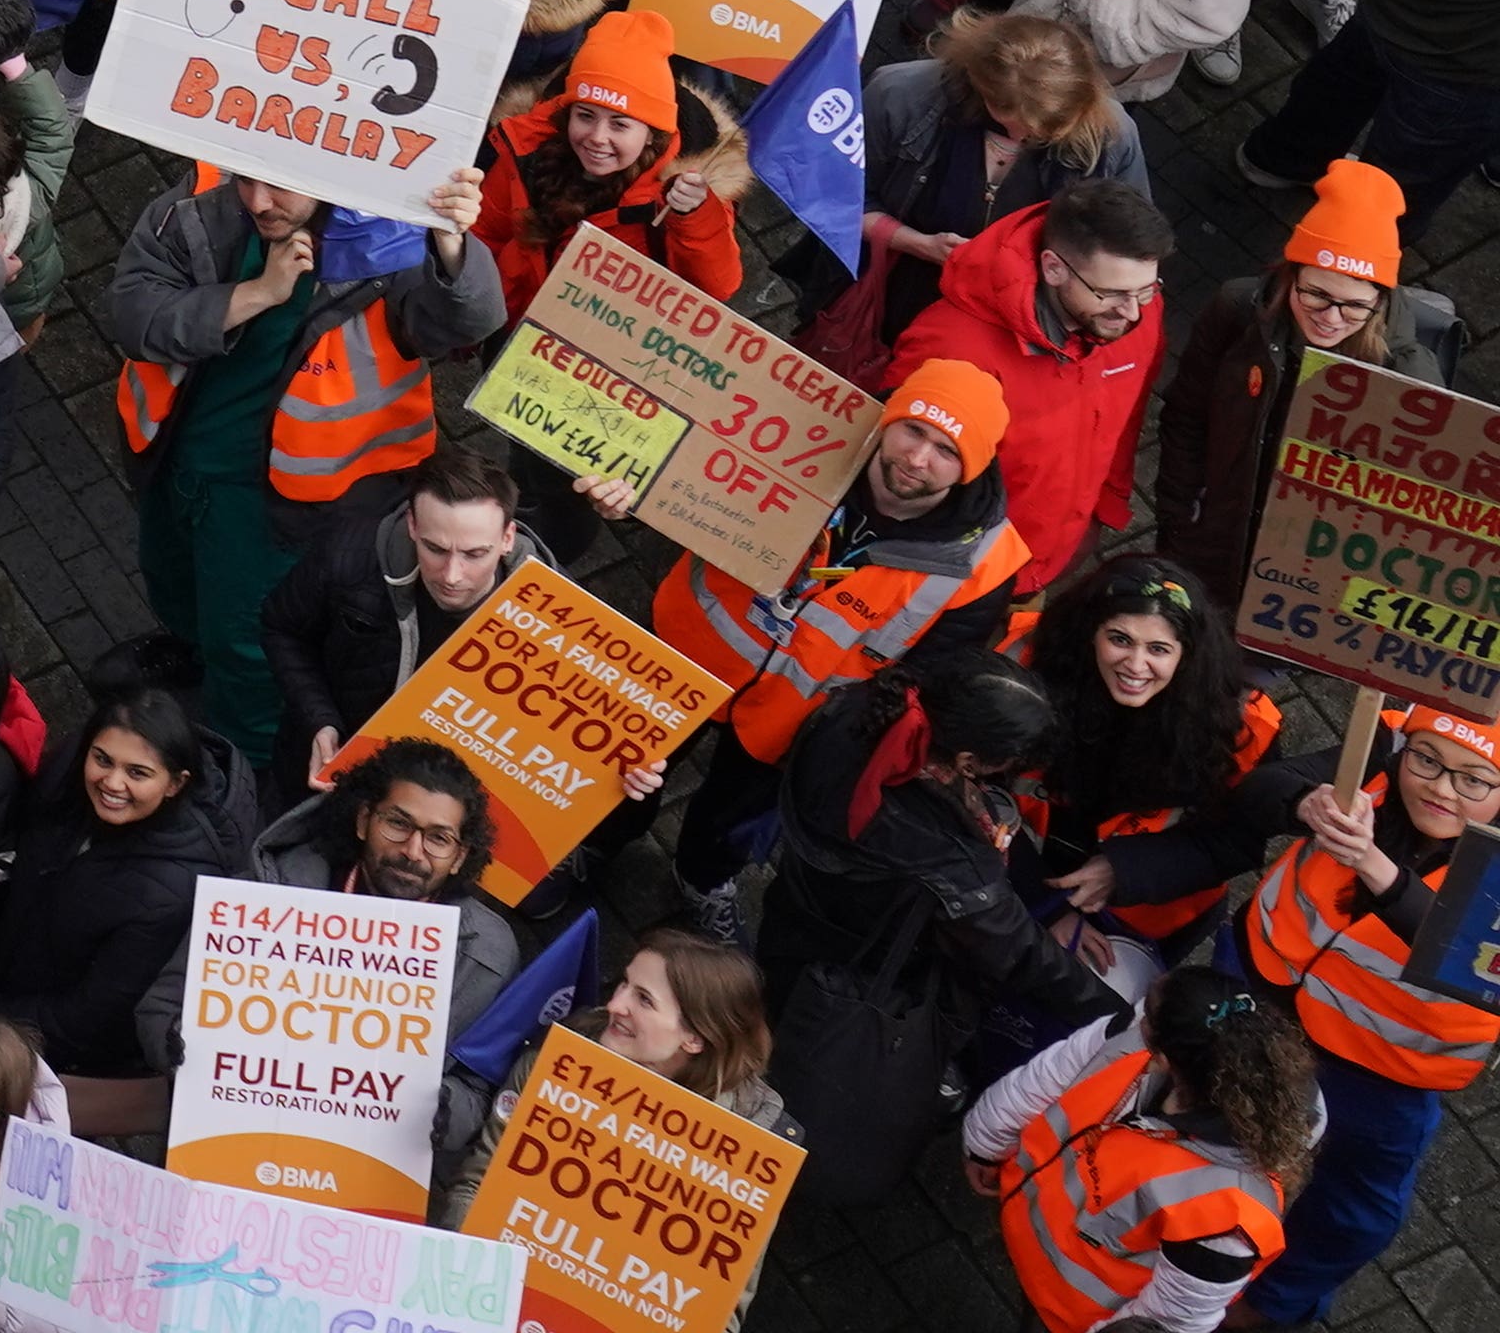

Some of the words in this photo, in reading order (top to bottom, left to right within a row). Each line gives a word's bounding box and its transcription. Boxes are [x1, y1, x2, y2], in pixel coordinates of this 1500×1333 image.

[571, 240, 723, 338] REDUCED
[725, 322, 769, 365] TO
[769, 353, 867, 425] CLEAR
[709, 393, 848, 480] 30%
[703, 448, 798, 516] OFF
